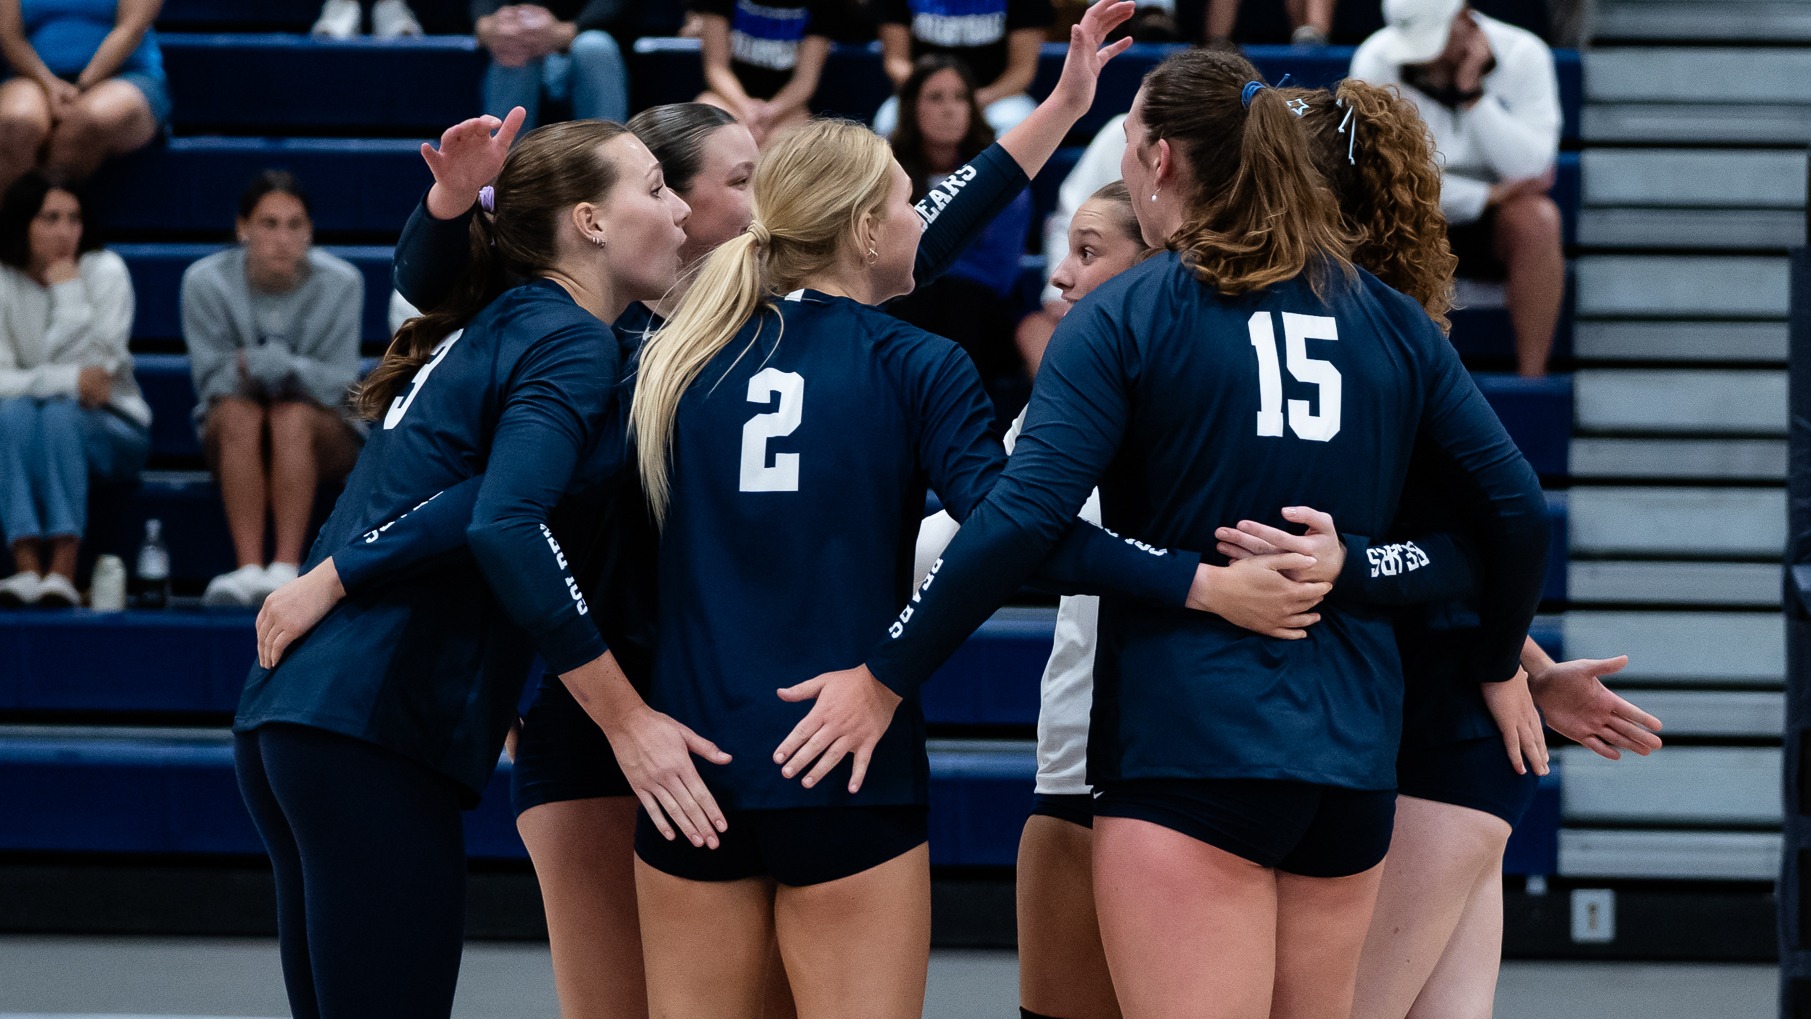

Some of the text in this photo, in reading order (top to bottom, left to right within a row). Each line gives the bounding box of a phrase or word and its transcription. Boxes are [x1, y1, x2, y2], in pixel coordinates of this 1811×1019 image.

[914, 164, 977, 234] EARS
[1248, 311, 1342, 442] 15
[739, 367, 805, 492] 2
[1366, 540, 1431, 578] BEARS
